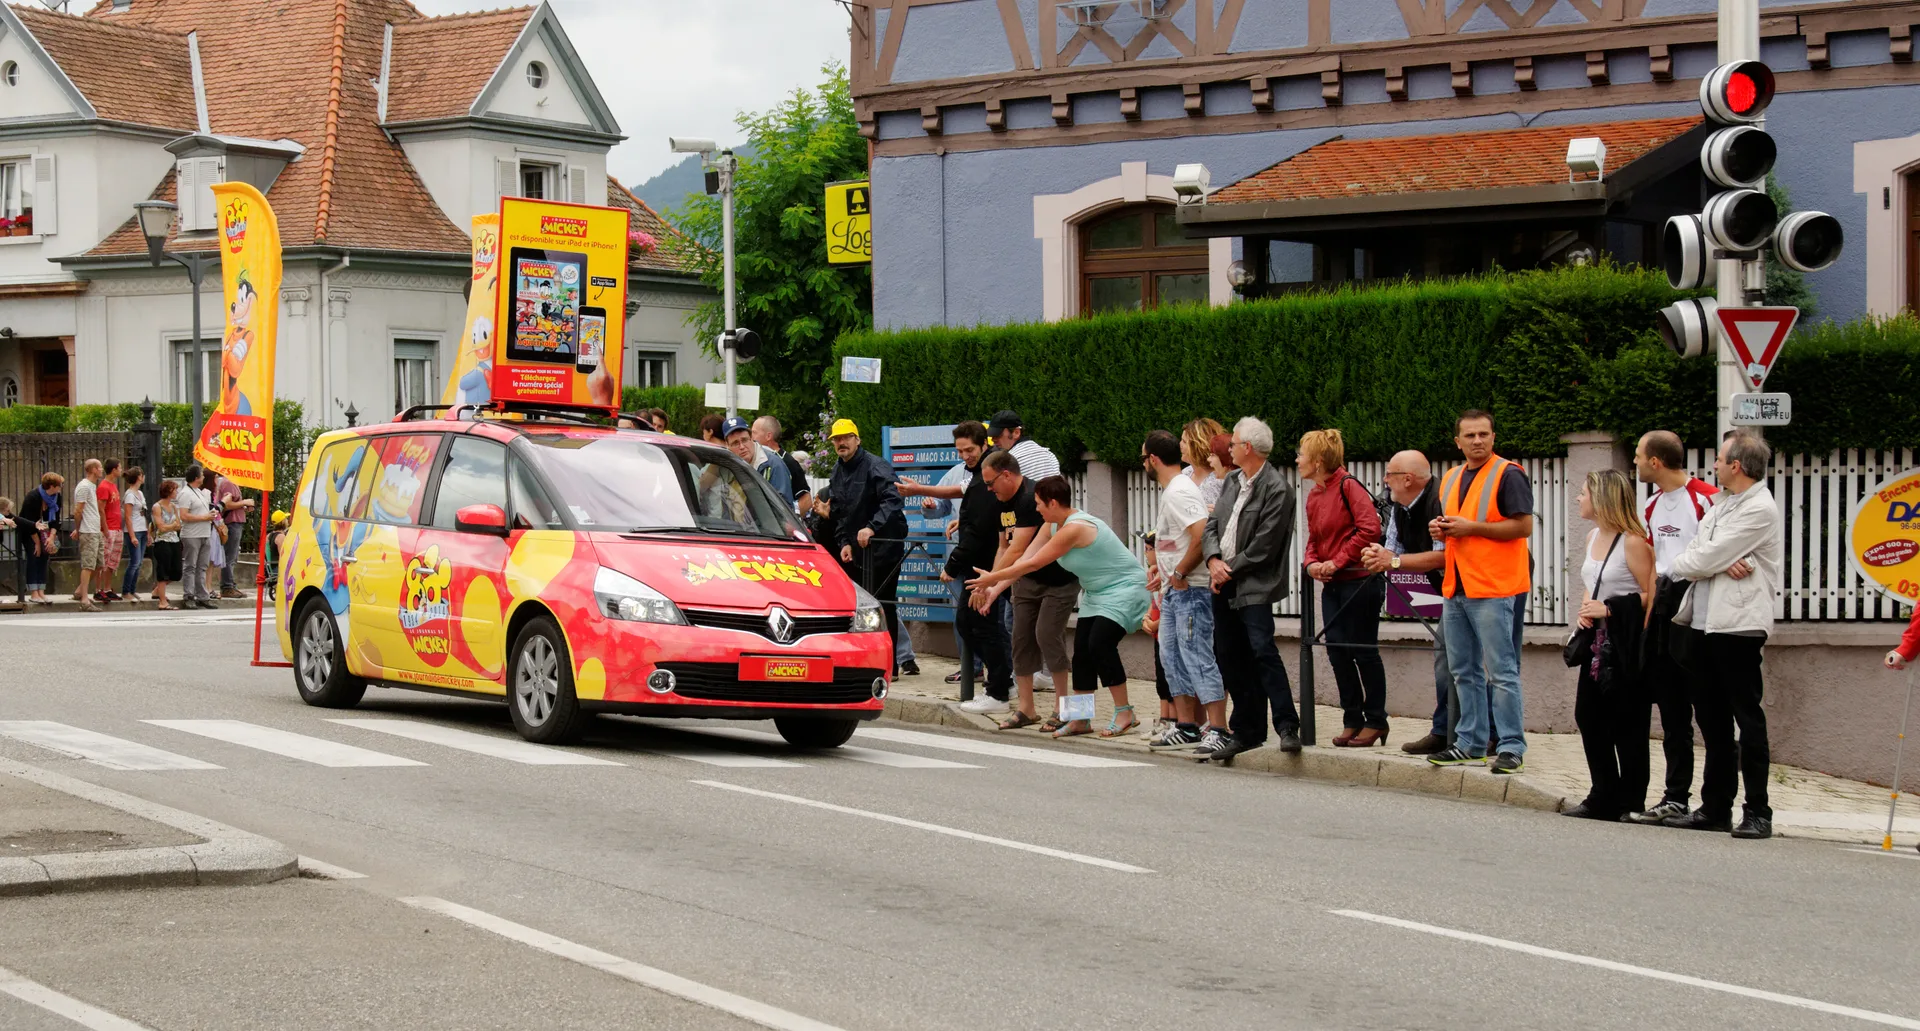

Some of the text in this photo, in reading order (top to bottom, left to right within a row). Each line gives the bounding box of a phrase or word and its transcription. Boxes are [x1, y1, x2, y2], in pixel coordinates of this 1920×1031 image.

[542, 221, 587, 236] MICKEY
[520, 235, 554, 245] disponible
[567, 239, 582, 247] iPad
[830, 217, 871, 256] Log
[521, 266, 557, 277] MICKEY
[520, 374, 556, 383] Téléchargez
[916, 452, 938, 462] AMACO
[1864, 545, 1884, 558] Expo
[705, 553, 786, 563] JOURNAL
[901, 562, 925, 573] ULTIBAT
[685, 560, 823, 588] MICKEY
[918, 584, 946, 595] MAJICAP
[1897, 579, 1919, 598] 03
[412, 635, 449, 654] MICKEY
[772, 666, 806, 676] MICKEY
